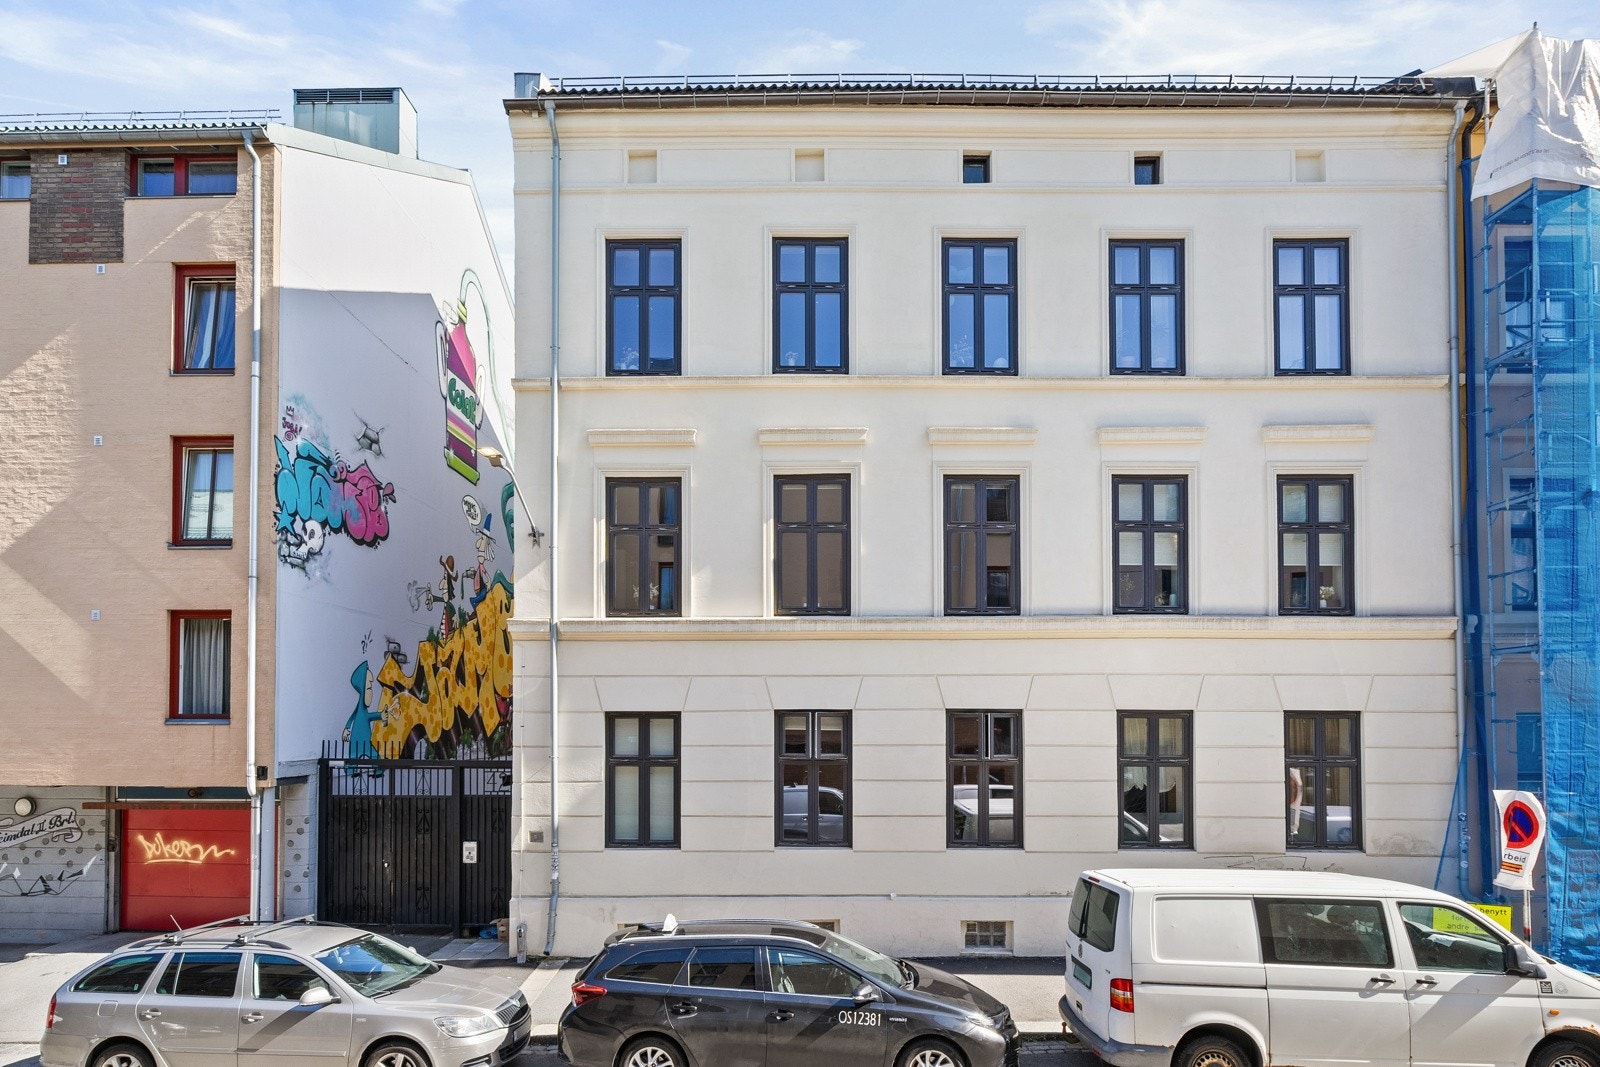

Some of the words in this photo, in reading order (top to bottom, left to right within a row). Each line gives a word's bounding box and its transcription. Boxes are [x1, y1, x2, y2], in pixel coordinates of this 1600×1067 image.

[0, 824, 36, 843] eimdal
[1503, 853, 1527, 863] rbeid
[838, 1010, 881, 1027] OS12381
